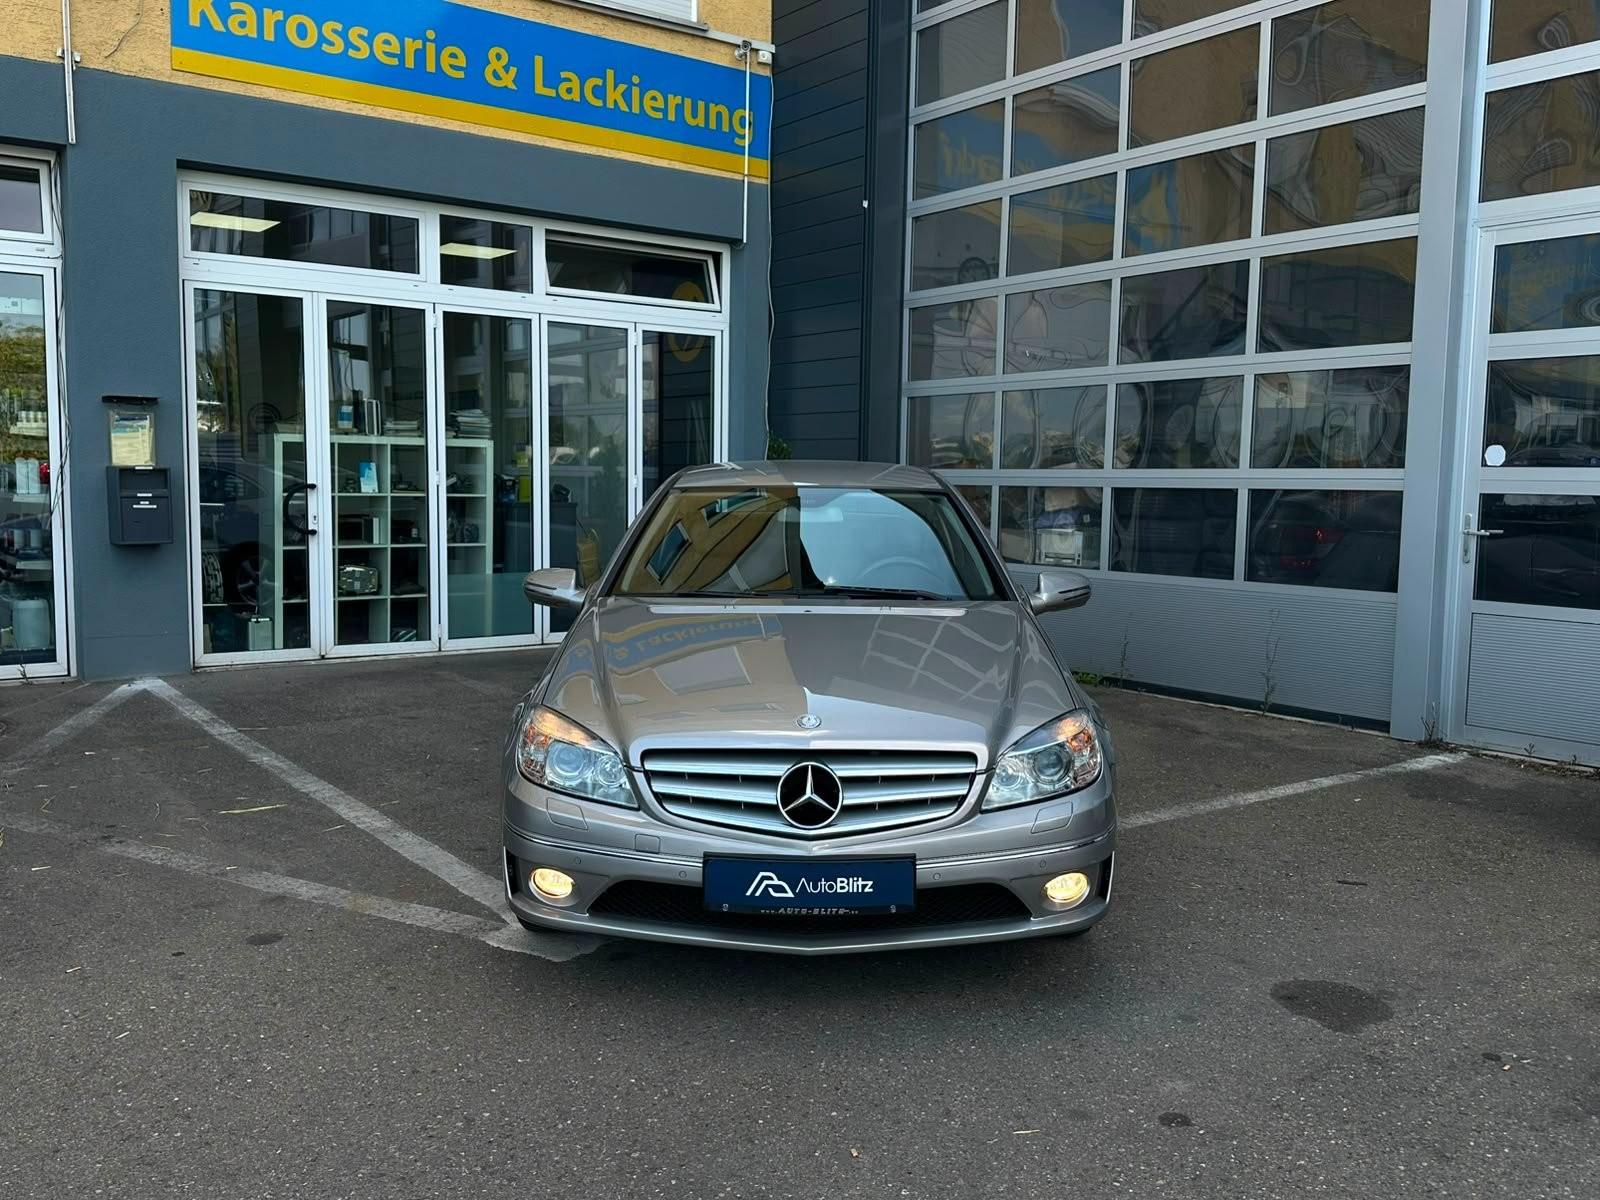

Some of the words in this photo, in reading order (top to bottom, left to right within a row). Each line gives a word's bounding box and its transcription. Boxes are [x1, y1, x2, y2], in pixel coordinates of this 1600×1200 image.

[188, 0, 467, 79] Karosserie
[484, 47, 517, 91] &
[534, 56, 754, 145] Lackierung
[796, 877, 873, 893] AutoBlitz
